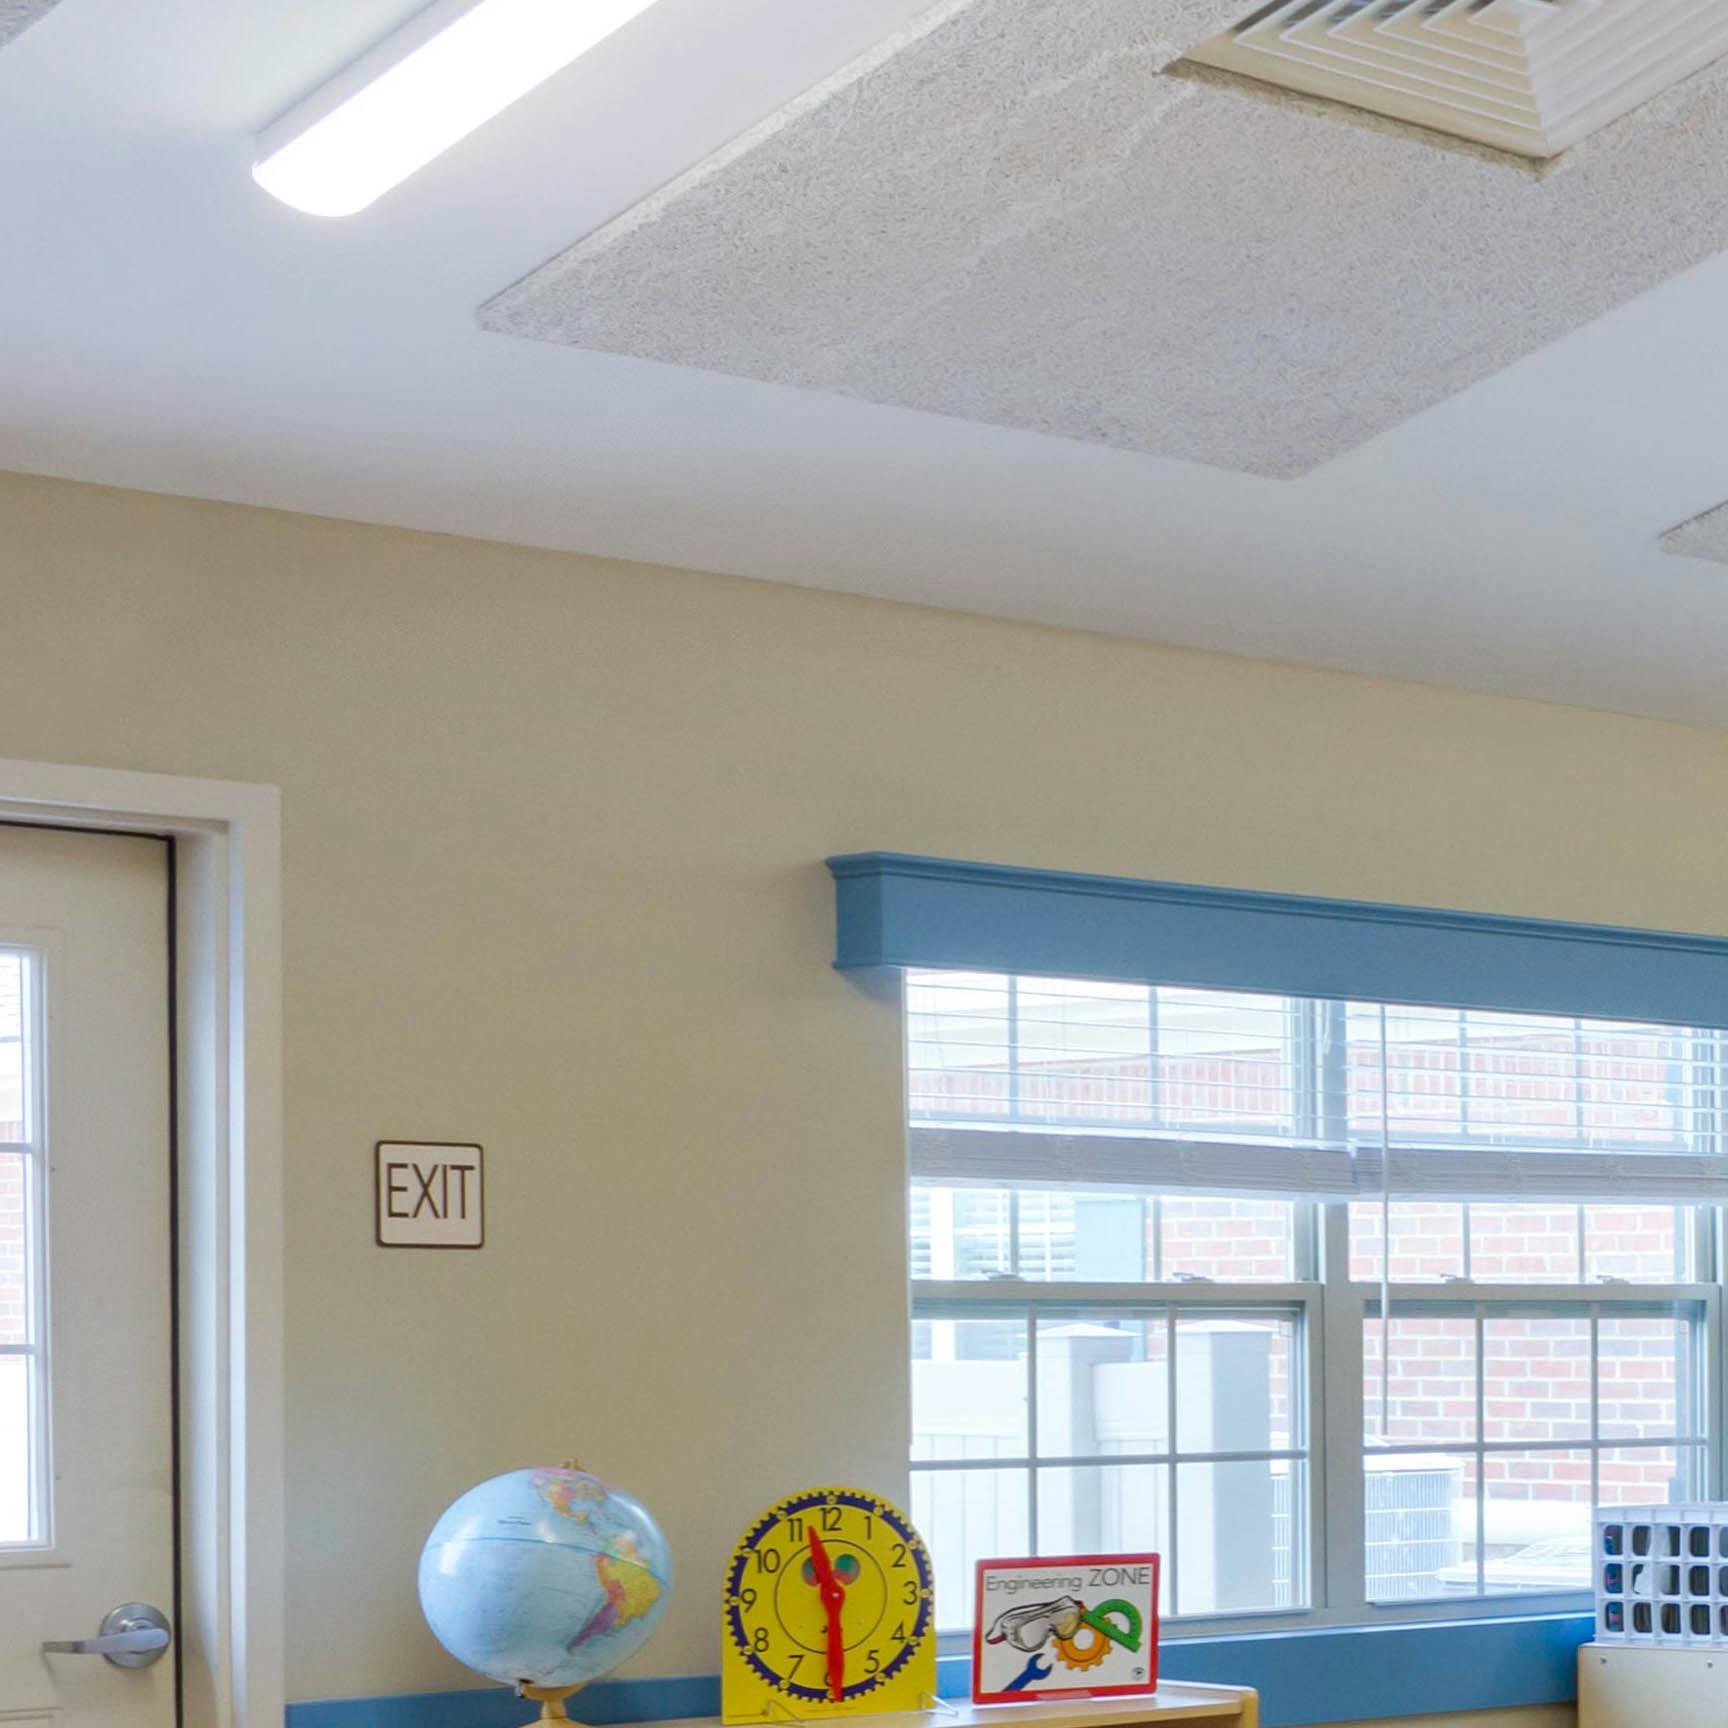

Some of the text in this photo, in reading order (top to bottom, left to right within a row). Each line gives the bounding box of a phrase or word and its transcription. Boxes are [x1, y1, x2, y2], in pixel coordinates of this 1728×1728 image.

[387, 1163, 475, 1219] EXIT
[787, 1518, 804, 1542] 11
[820, 1506, 843, 1532] 12
[863, 1515, 872, 1540] 1
[755, 1548, 782, 1574] 10
[891, 1543, 907, 1568] 2
[903, 1580, 918, 1606] 3
[986, 1567, 1150, 1595] Engineering ZONE
[741, 1588, 758, 1614] 9
[753, 1627, 770, 1653] 8
[890, 1620, 907, 1644] 4
[787, 1654, 804, 1680] 7
[864, 1649, 880, 1674] 5
